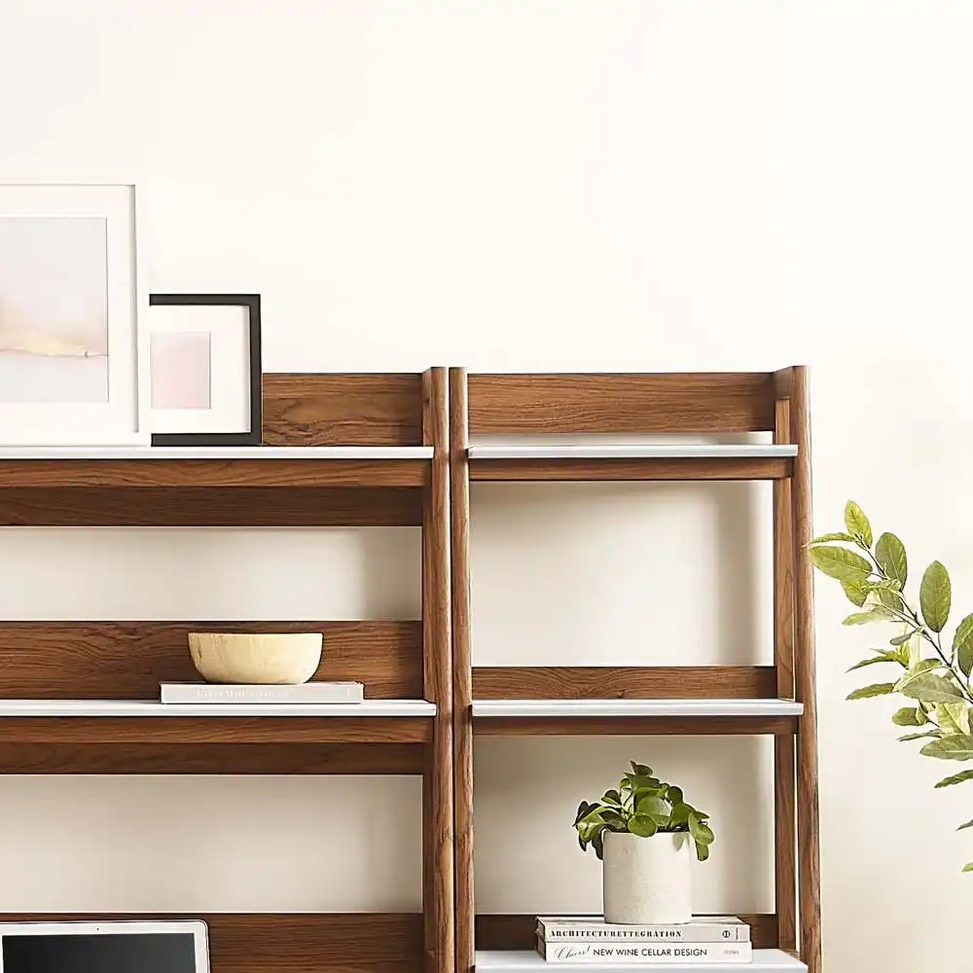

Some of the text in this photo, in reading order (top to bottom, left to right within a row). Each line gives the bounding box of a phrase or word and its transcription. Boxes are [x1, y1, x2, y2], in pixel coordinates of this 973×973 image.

[593, 948, 614, 956] NEW
[616, 948, 639, 956] WINE
[641, 948, 672, 957] CELLAR
[674, 948, 708, 957] DESIGN
